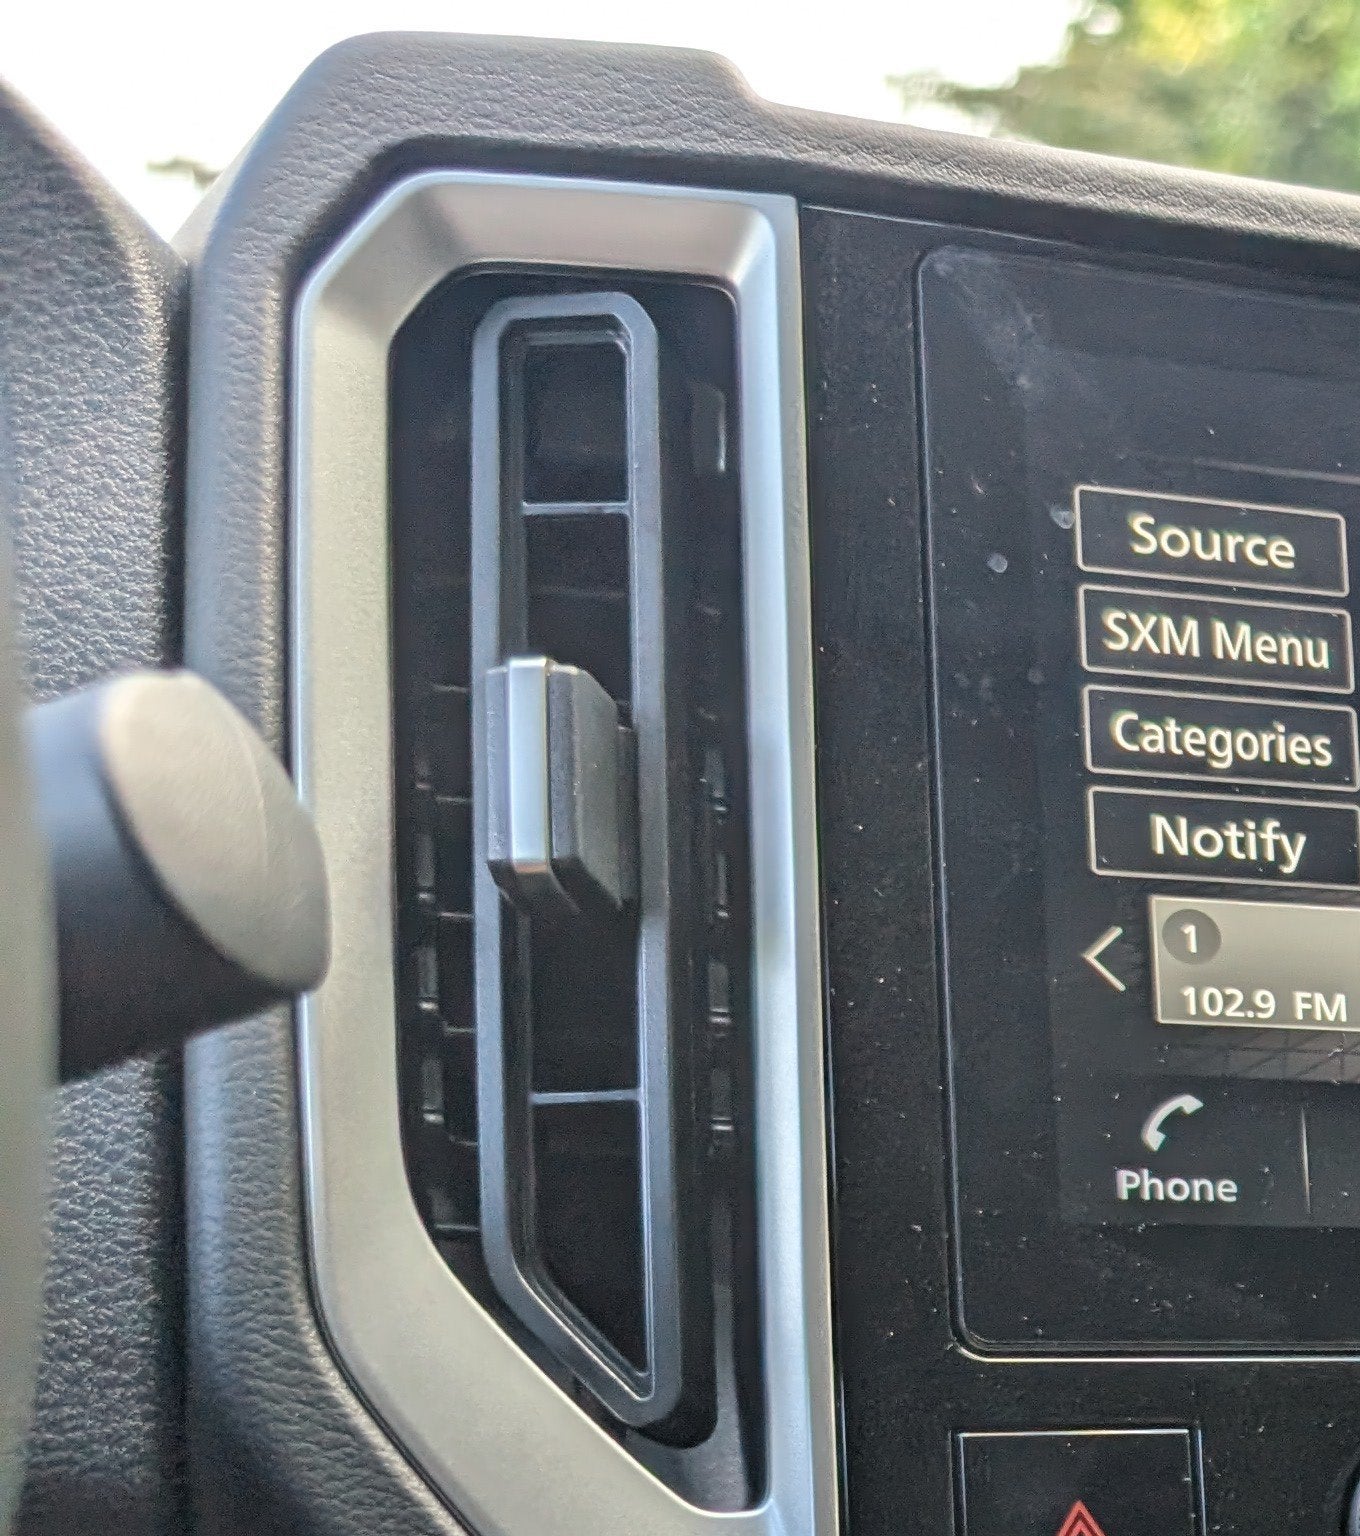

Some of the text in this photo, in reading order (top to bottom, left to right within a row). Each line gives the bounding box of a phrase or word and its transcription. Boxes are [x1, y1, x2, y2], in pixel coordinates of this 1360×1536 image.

[1127, 512, 1297, 570] Source
[1102, 610, 1329, 670] SXM Menu
[1111, 710, 1333, 769] Categories
[1151, 814, 1307, 874] Notify
[1181, 923, 1199, 954] 1
[1182, 986, 1348, 1024] 102.9 FM
[1115, 1169, 1239, 1204] Phone
